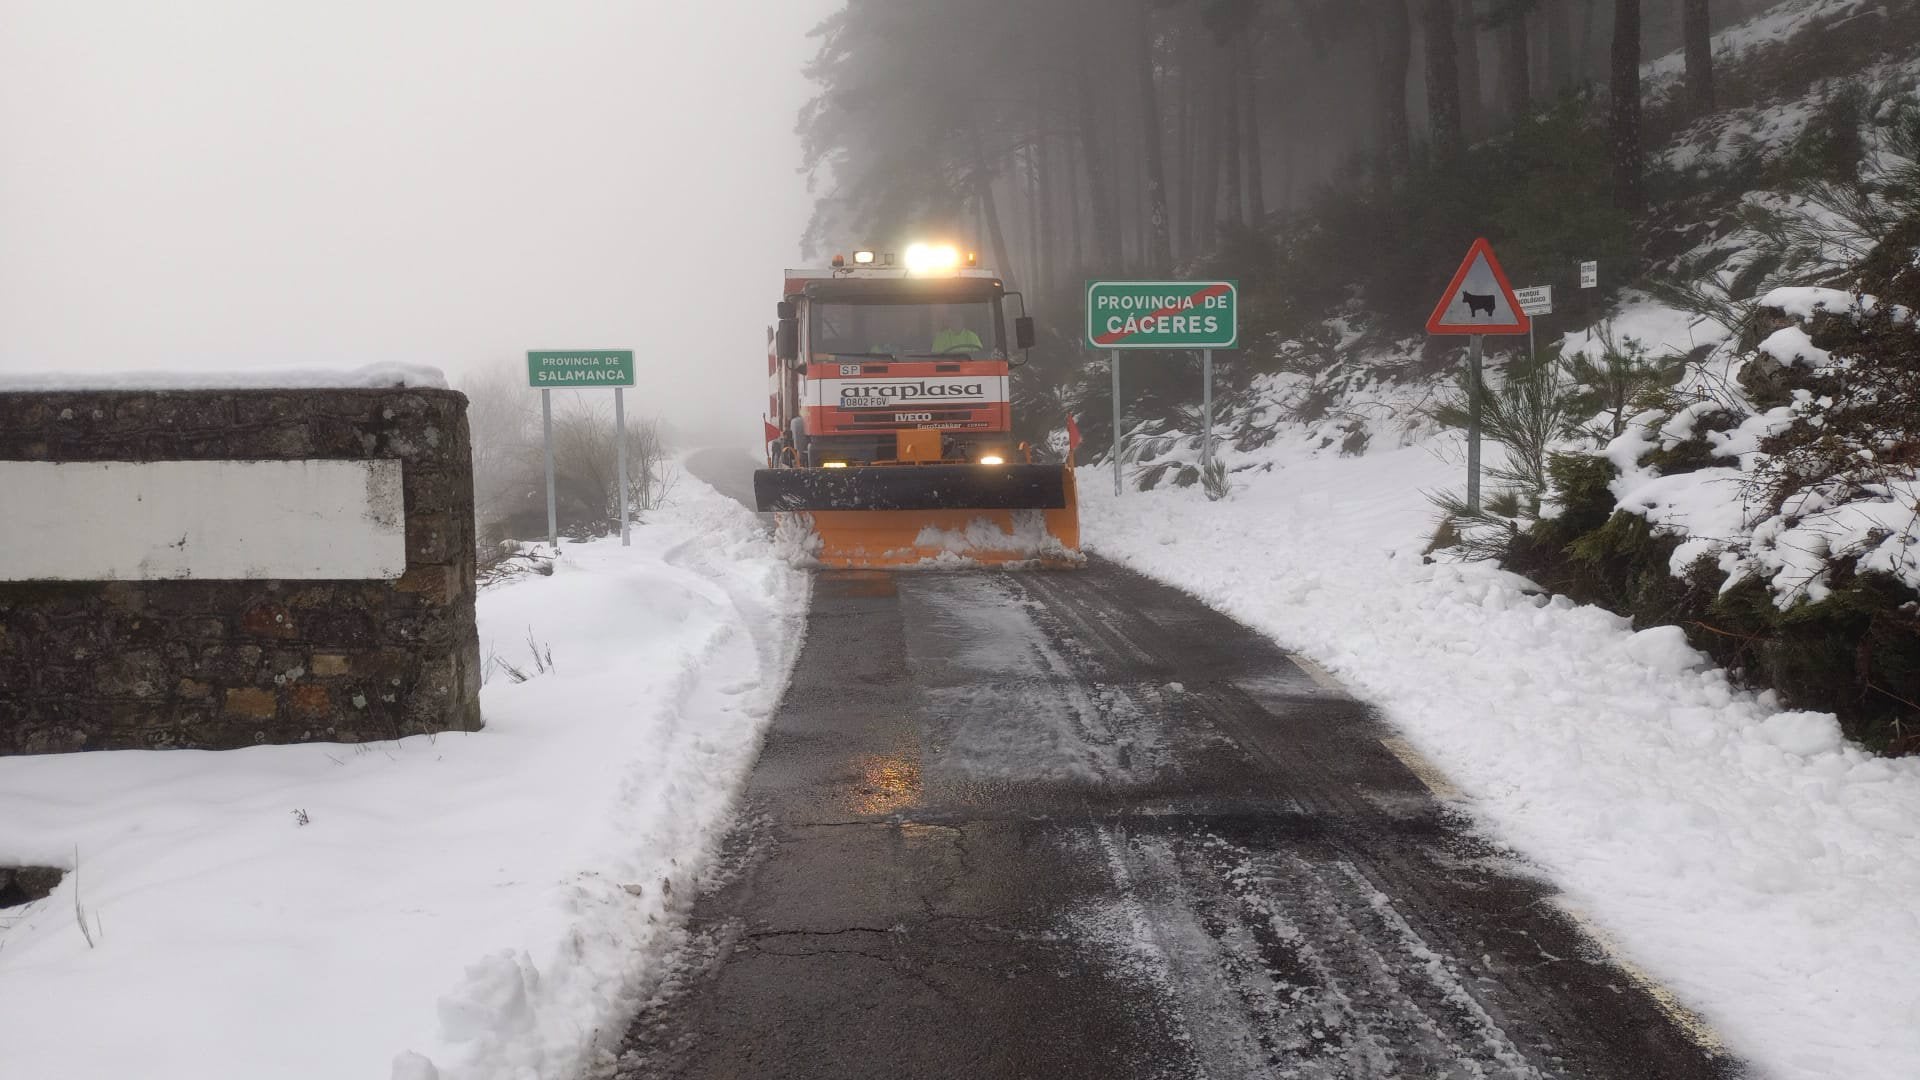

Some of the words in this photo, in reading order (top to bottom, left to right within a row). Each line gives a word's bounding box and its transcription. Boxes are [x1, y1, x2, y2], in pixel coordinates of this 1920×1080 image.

[1519, 290, 1539, 298] PARQUE
[1098, 295, 1194, 309] PROVINCIA
[1204, 295, 1227, 309] DE
[1106, 312, 1218, 334] CÁCERES
[542, 357, 600, 366] PROVINCIA
[605, 357, 620, 365] DE
[538, 369, 625, 381] SALAMANCA
[842, 365, 859, 375] SP
[840, 380, 984, 401] araplasa
[846, 398, 869, 407] 0802
[870, 398, 888, 407] FGV
[895, 412, 932, 422] IVECO
